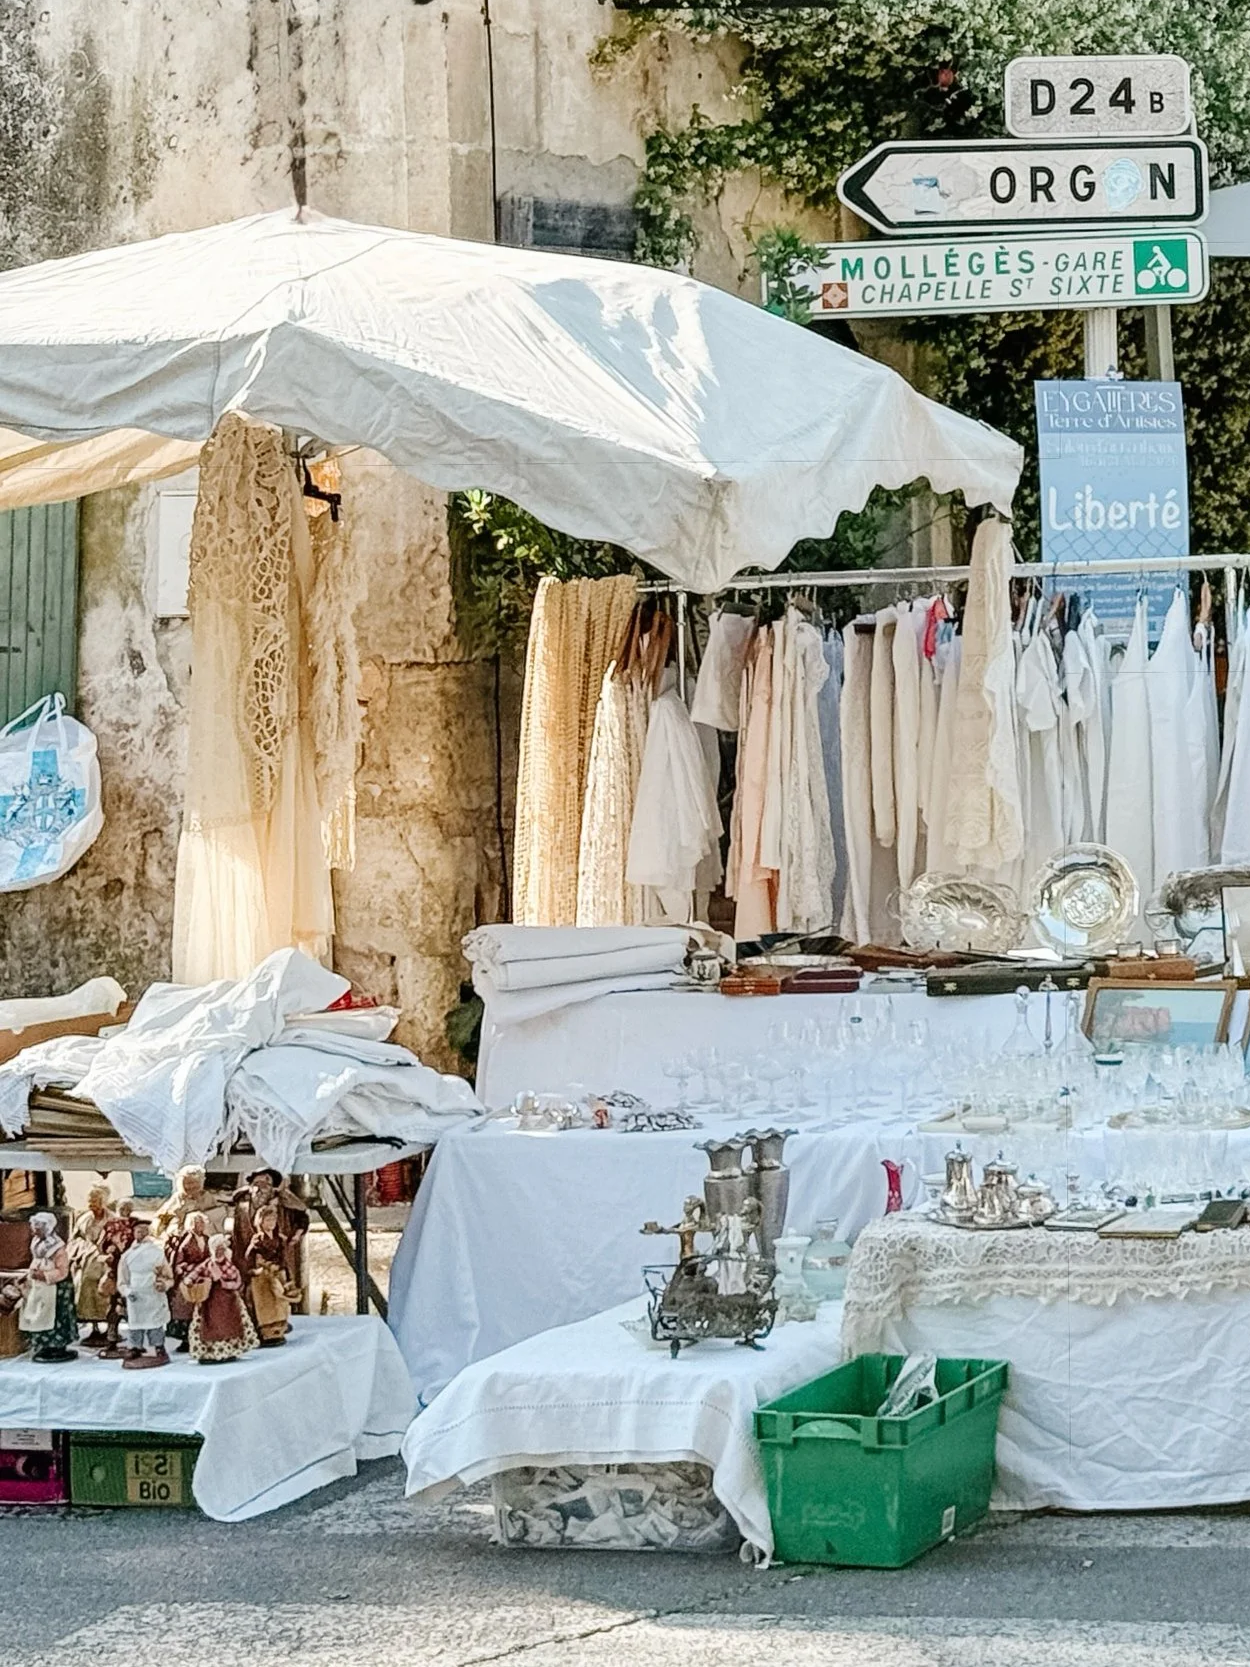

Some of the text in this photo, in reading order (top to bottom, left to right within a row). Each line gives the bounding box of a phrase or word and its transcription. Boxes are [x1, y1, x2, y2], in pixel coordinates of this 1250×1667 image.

[989, 162, 1176, 204] ORGN
[860, 280, 993, 306] CHAPELLE
[1049, 273, 1125, 297] SIXTE
[1044, 412, 1094, 429] Terre
[1047, 483, 1183, 532] Liberté
